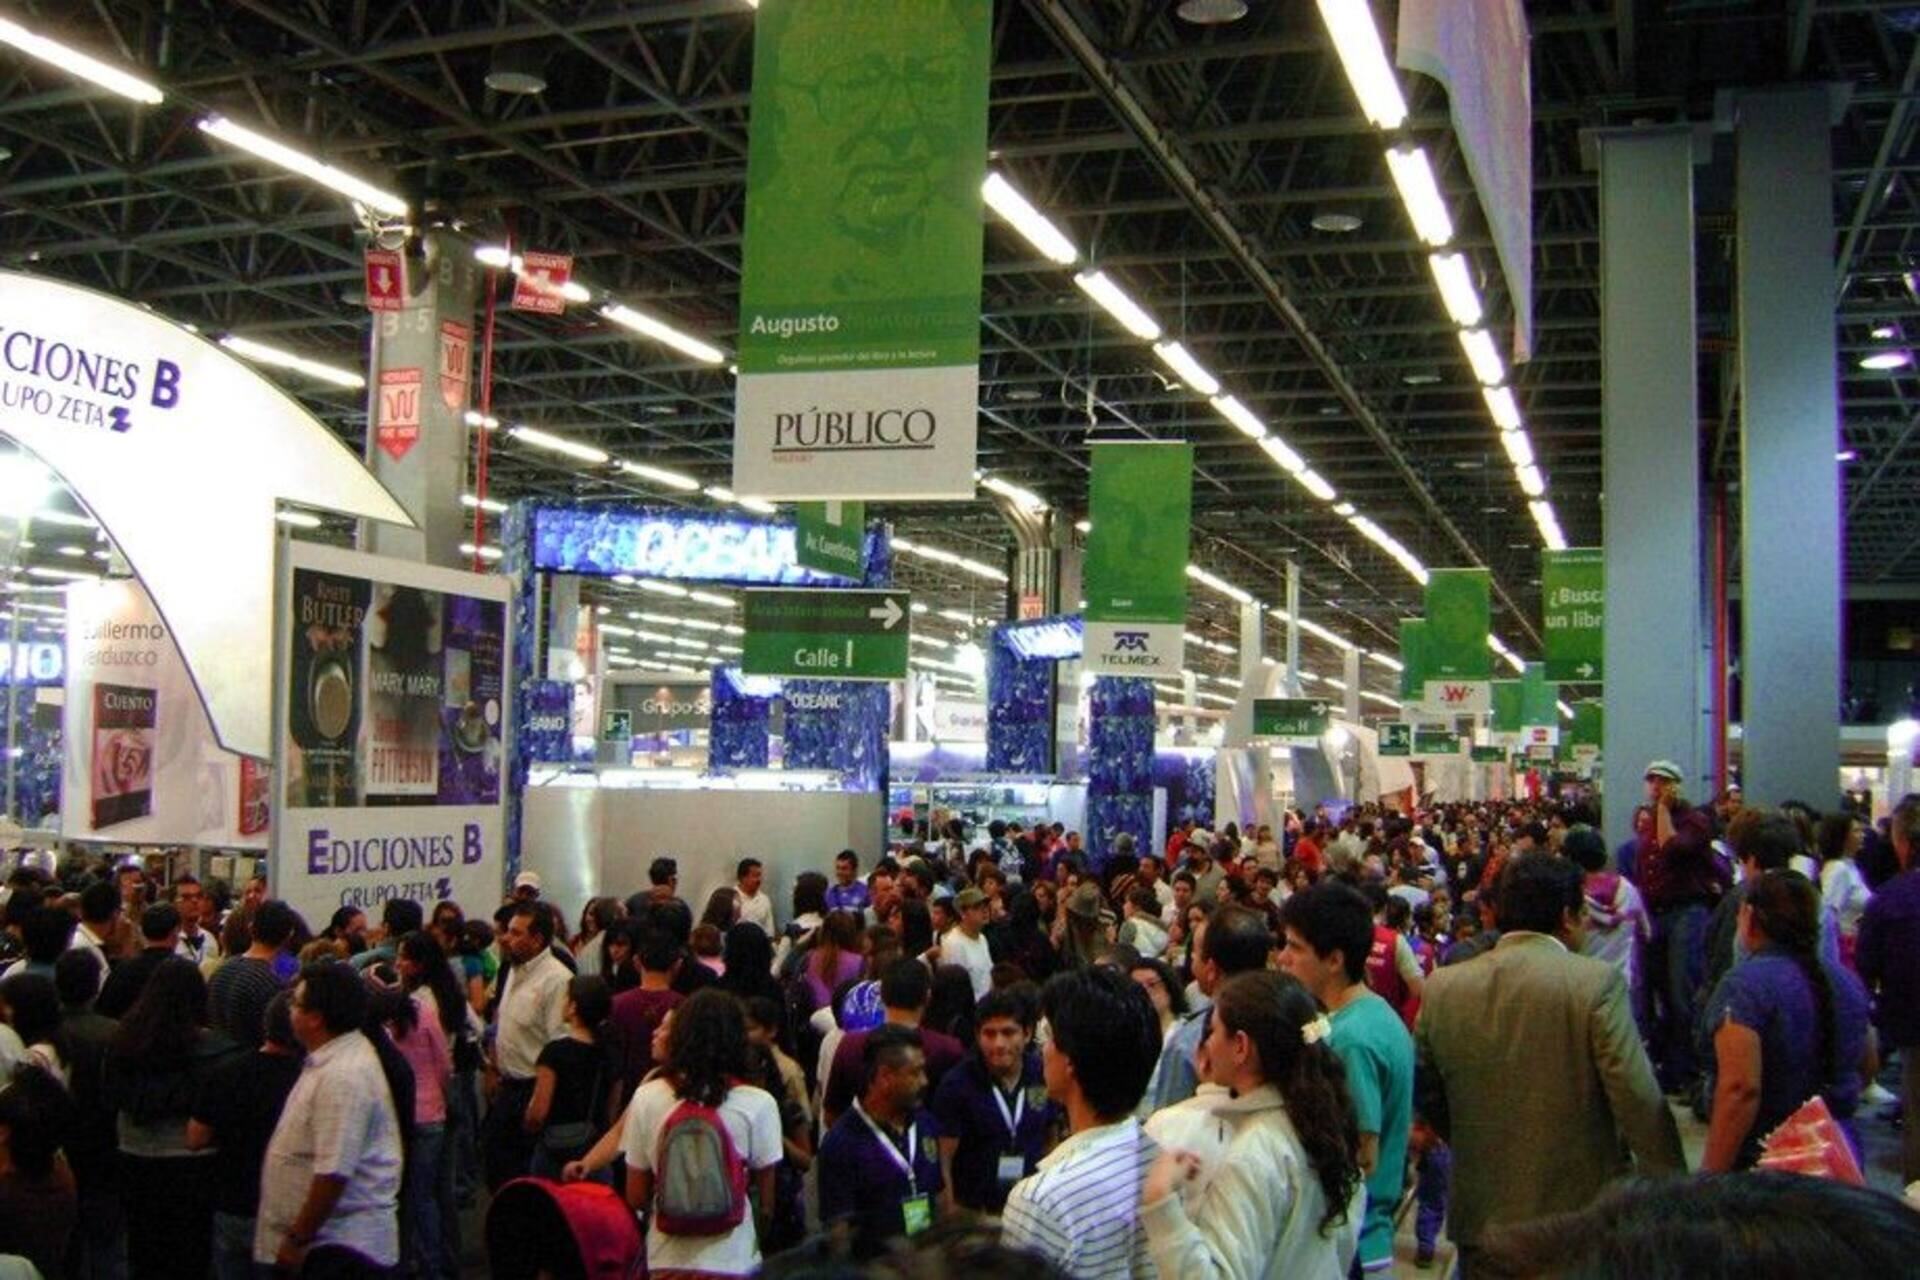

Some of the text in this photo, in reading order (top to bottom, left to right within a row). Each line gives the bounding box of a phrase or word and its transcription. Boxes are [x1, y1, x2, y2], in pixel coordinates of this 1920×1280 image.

[751, 314, 840, 338] Augusto
[0, 326, 181, 410] CIONES B
[57, 395, 104, 427] ZETA
[775, 406, 936, 446] PÚBLICO
[1549, 587, 1604, 608] ¿Busc
[302, 594, 363, 627] BUTLER
[1545, 614, 1568, 629] un
[794, 648, 838, 668] Calle
[1101, 654, 1160, 666] TELMEX
[104, 692, 153, 710] CUENTO
[643, 699, 692, 719] Grupo
[307, 823, 482, 875] EDICIONES B
[399, 881, 433, 902] ZETA
